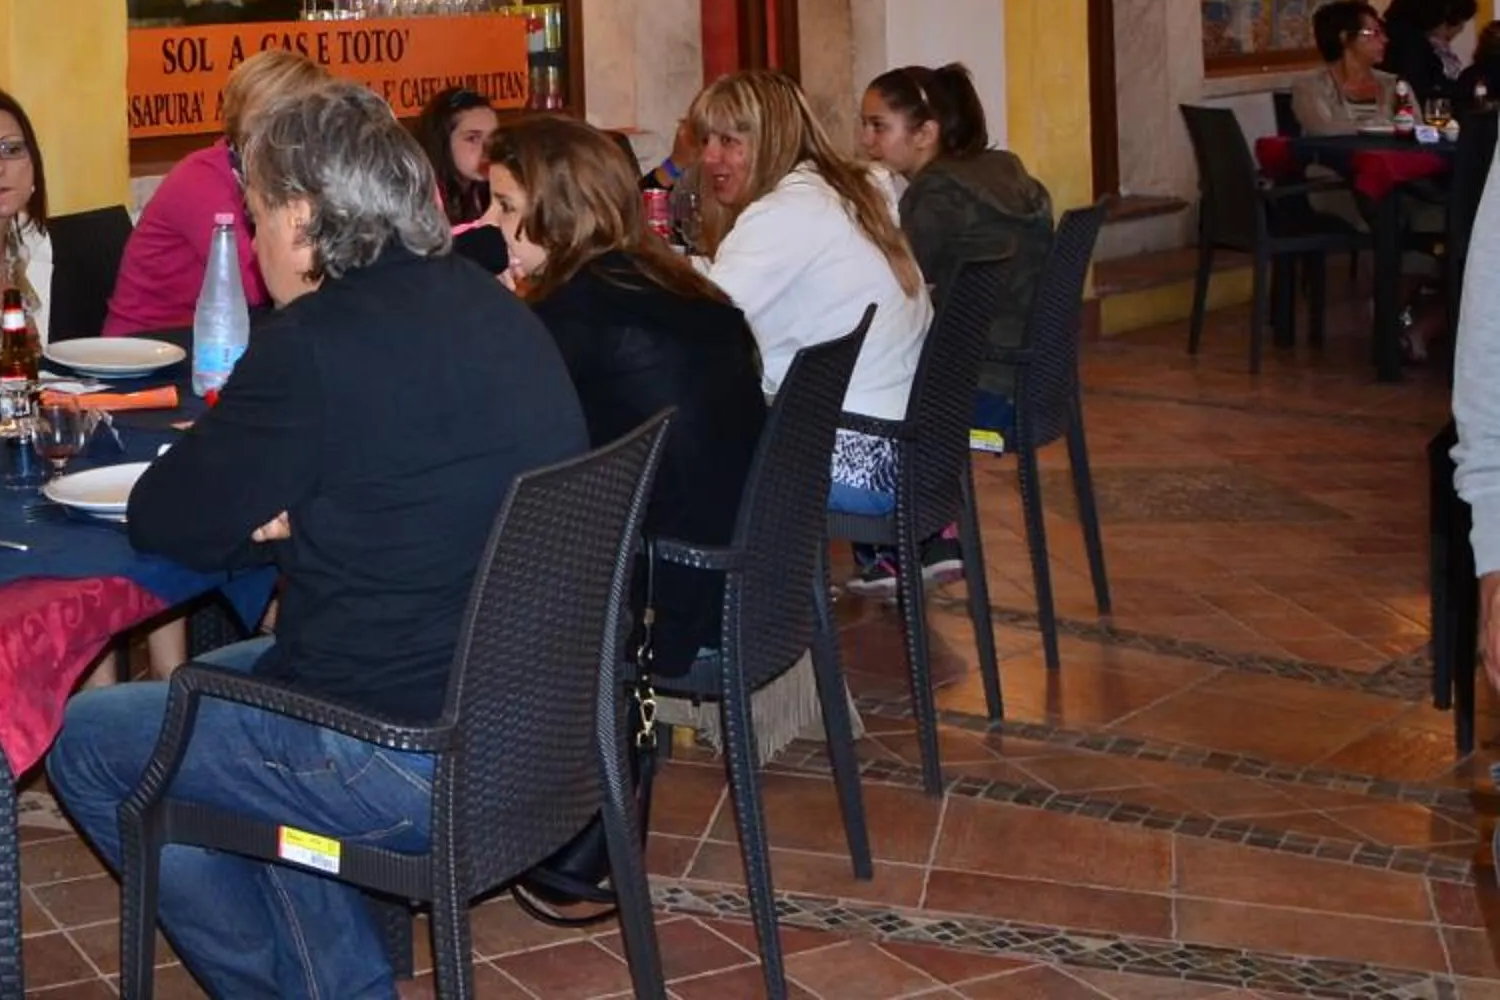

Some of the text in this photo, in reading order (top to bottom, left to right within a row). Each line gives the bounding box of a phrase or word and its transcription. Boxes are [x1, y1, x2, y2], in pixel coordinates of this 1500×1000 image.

[162, 37, 213, 74] SOL
[228, 35, 244, 70] A
[317, 33, 330, 65] E
[128, 91, 205, 128] SAPURA'
